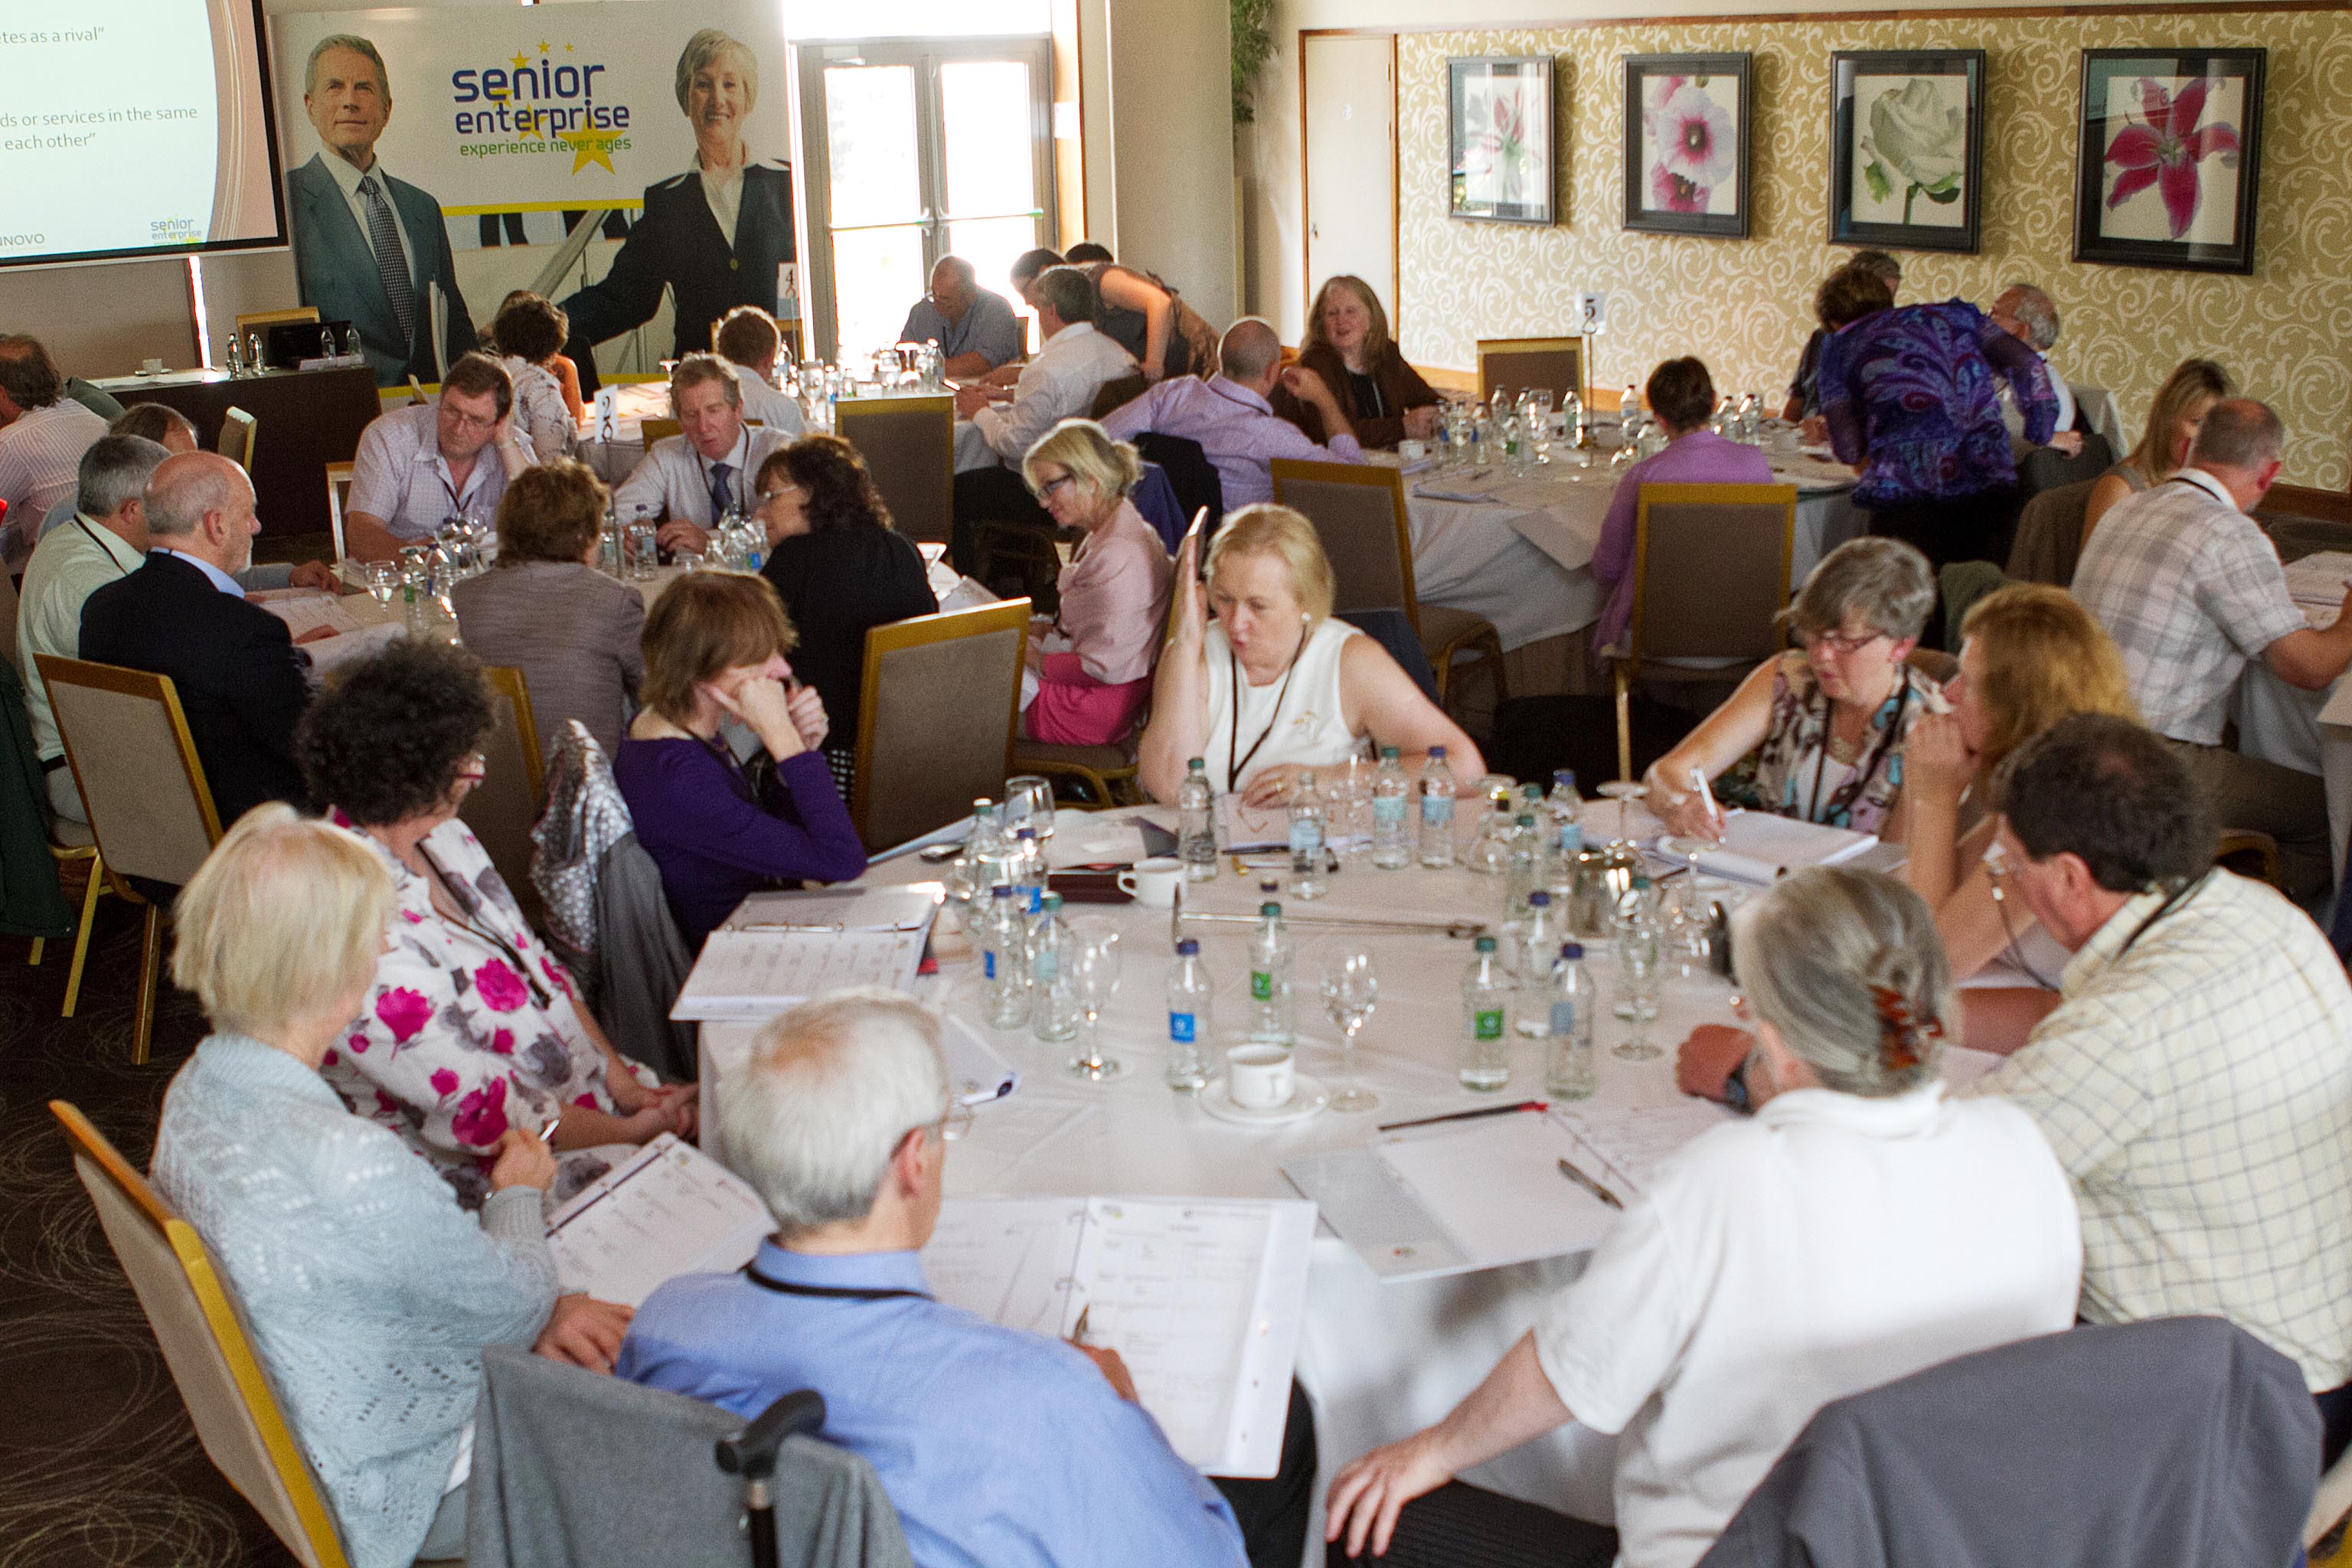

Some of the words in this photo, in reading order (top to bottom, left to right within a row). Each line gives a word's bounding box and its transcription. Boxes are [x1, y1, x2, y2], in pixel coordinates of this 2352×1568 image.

[0, 31, 27, 44] tes
[31, 31, 47, 43] as
[51, 31, 60, 42] a
[452, 59, 606, 103] senior
[21, 116, 38, 126] or
[43, 110, 106, 126] services
[109, 109, 122, 122] in
[127, 106, 152, 121] the
[156, 108, 198, 120] same
[456, 100, 630, 139] enterprise
[5, 134, 42, 150] each
[460, 139, 547, 159] experience
[550, 139, 594, 152] never
[596, 138, 632, 154] ages
[150, 219, 194, 230] senior
[152, 230, 202, 240] enterprise
[1585, 298, 1596, 320] 5
[602, 396, 611, 421] 2
